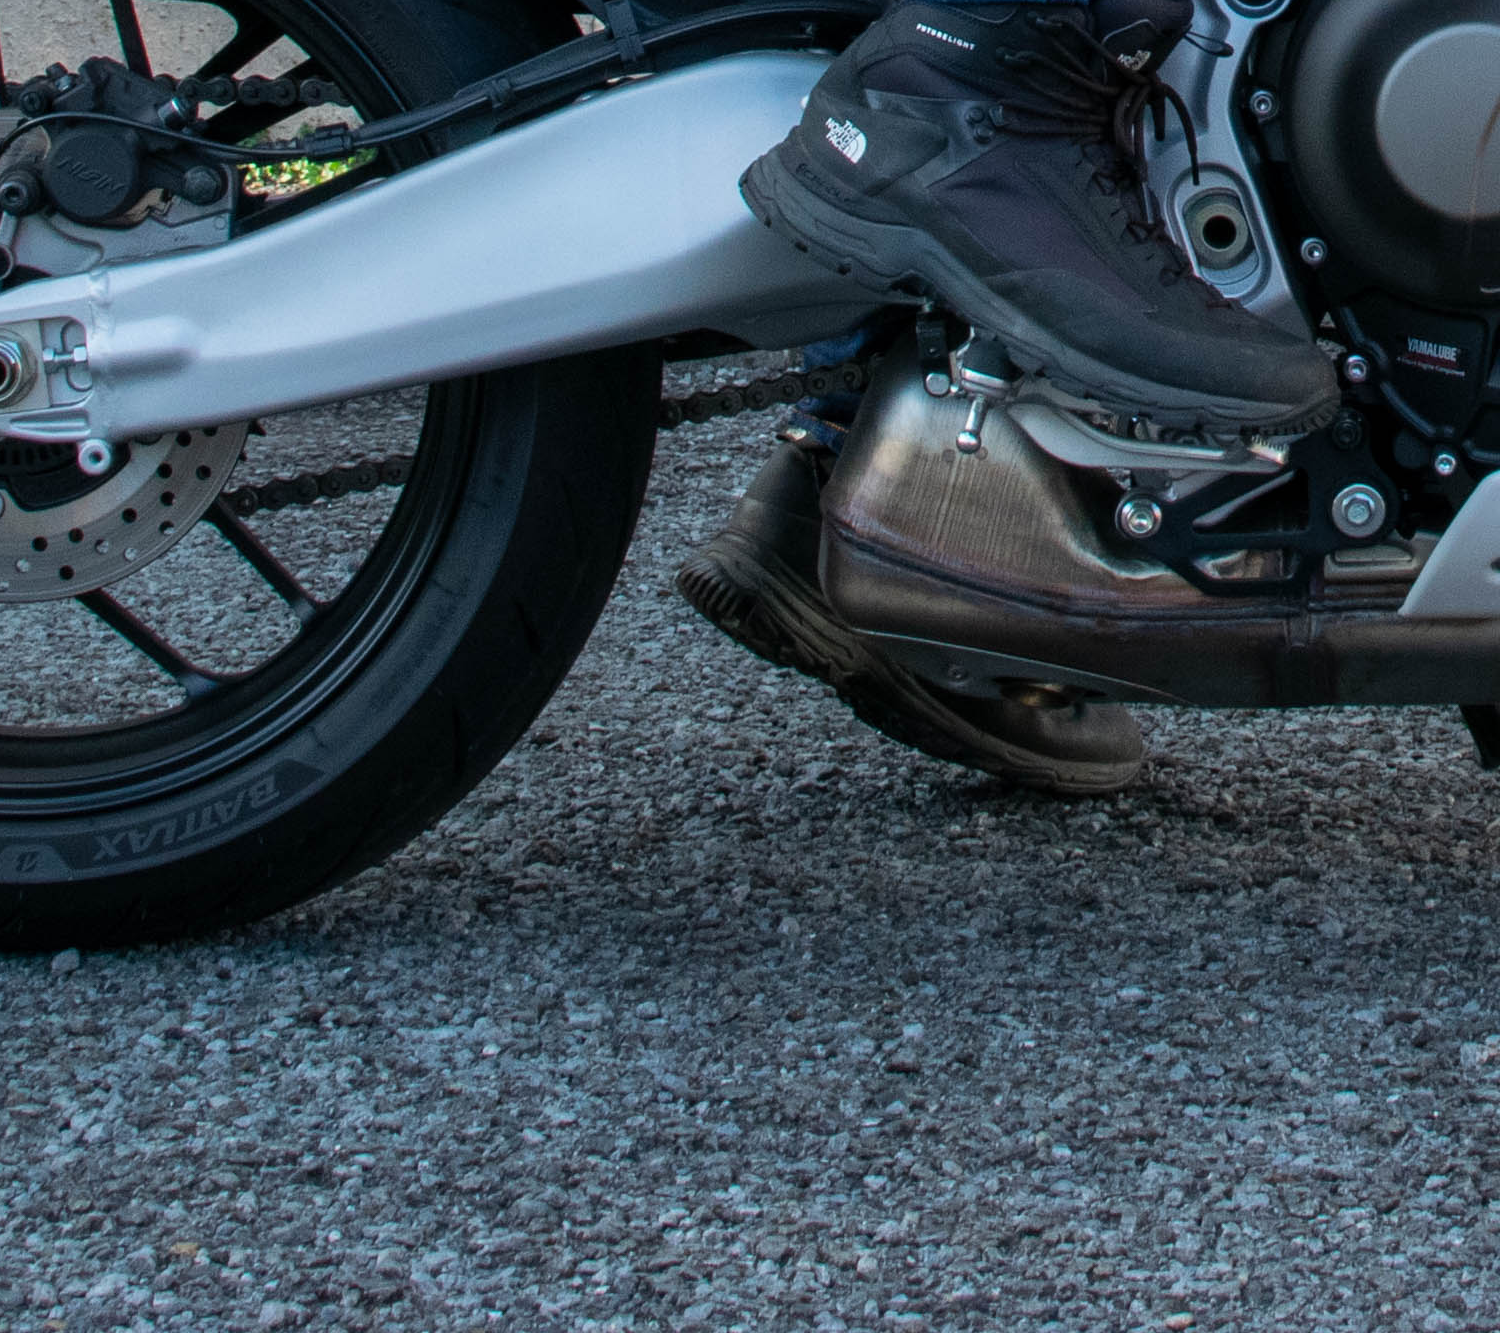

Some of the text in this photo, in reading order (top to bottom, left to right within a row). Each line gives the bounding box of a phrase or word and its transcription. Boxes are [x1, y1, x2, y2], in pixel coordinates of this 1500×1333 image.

[916, 23, 976, 50] FUTURELIGHT
[1407, 335, 1457, 362] YAMALUBE
[93, 774, 280, 862] BATTLAX
